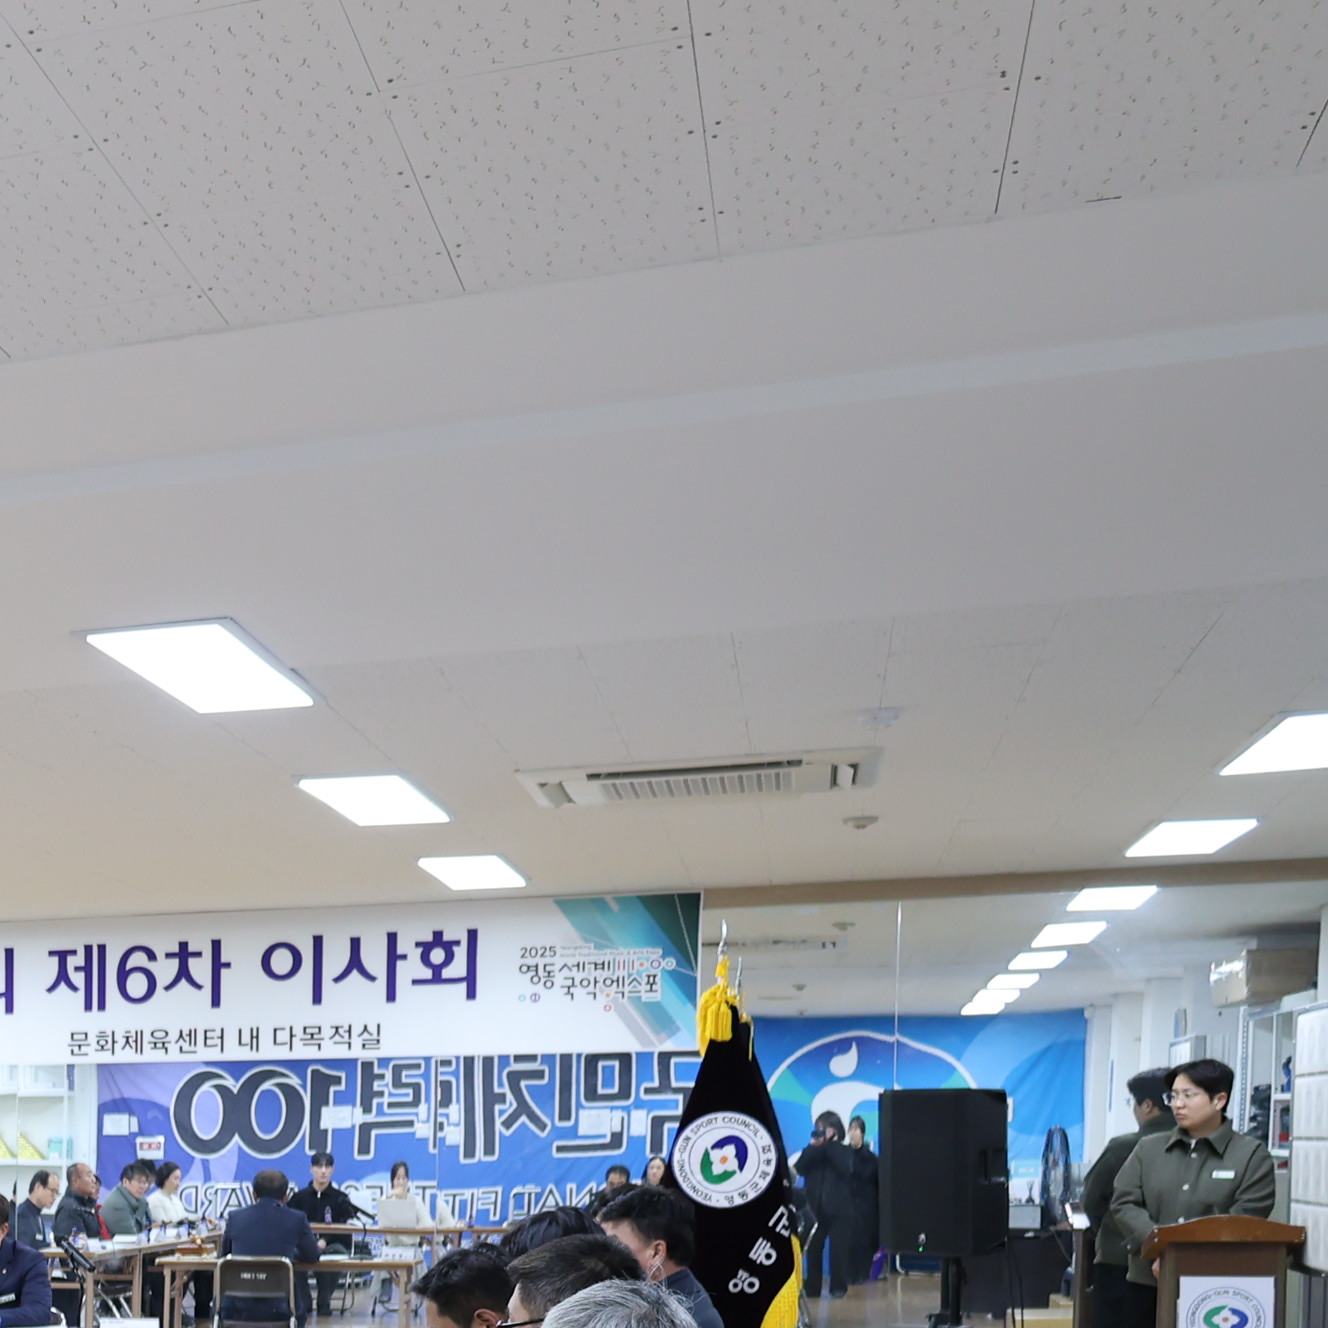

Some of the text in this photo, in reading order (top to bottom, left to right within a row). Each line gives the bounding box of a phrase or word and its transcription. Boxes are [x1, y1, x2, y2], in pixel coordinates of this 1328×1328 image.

[45, 934, 232, 1013] 제6차
[259, 927, 480, 1007] 이사회
[519, 945, 558, 959] 2025
[67, 1022, 382, 1057] 문화체육센터 내 다목적실
[728, 1204, 797, 1295] 영동군
